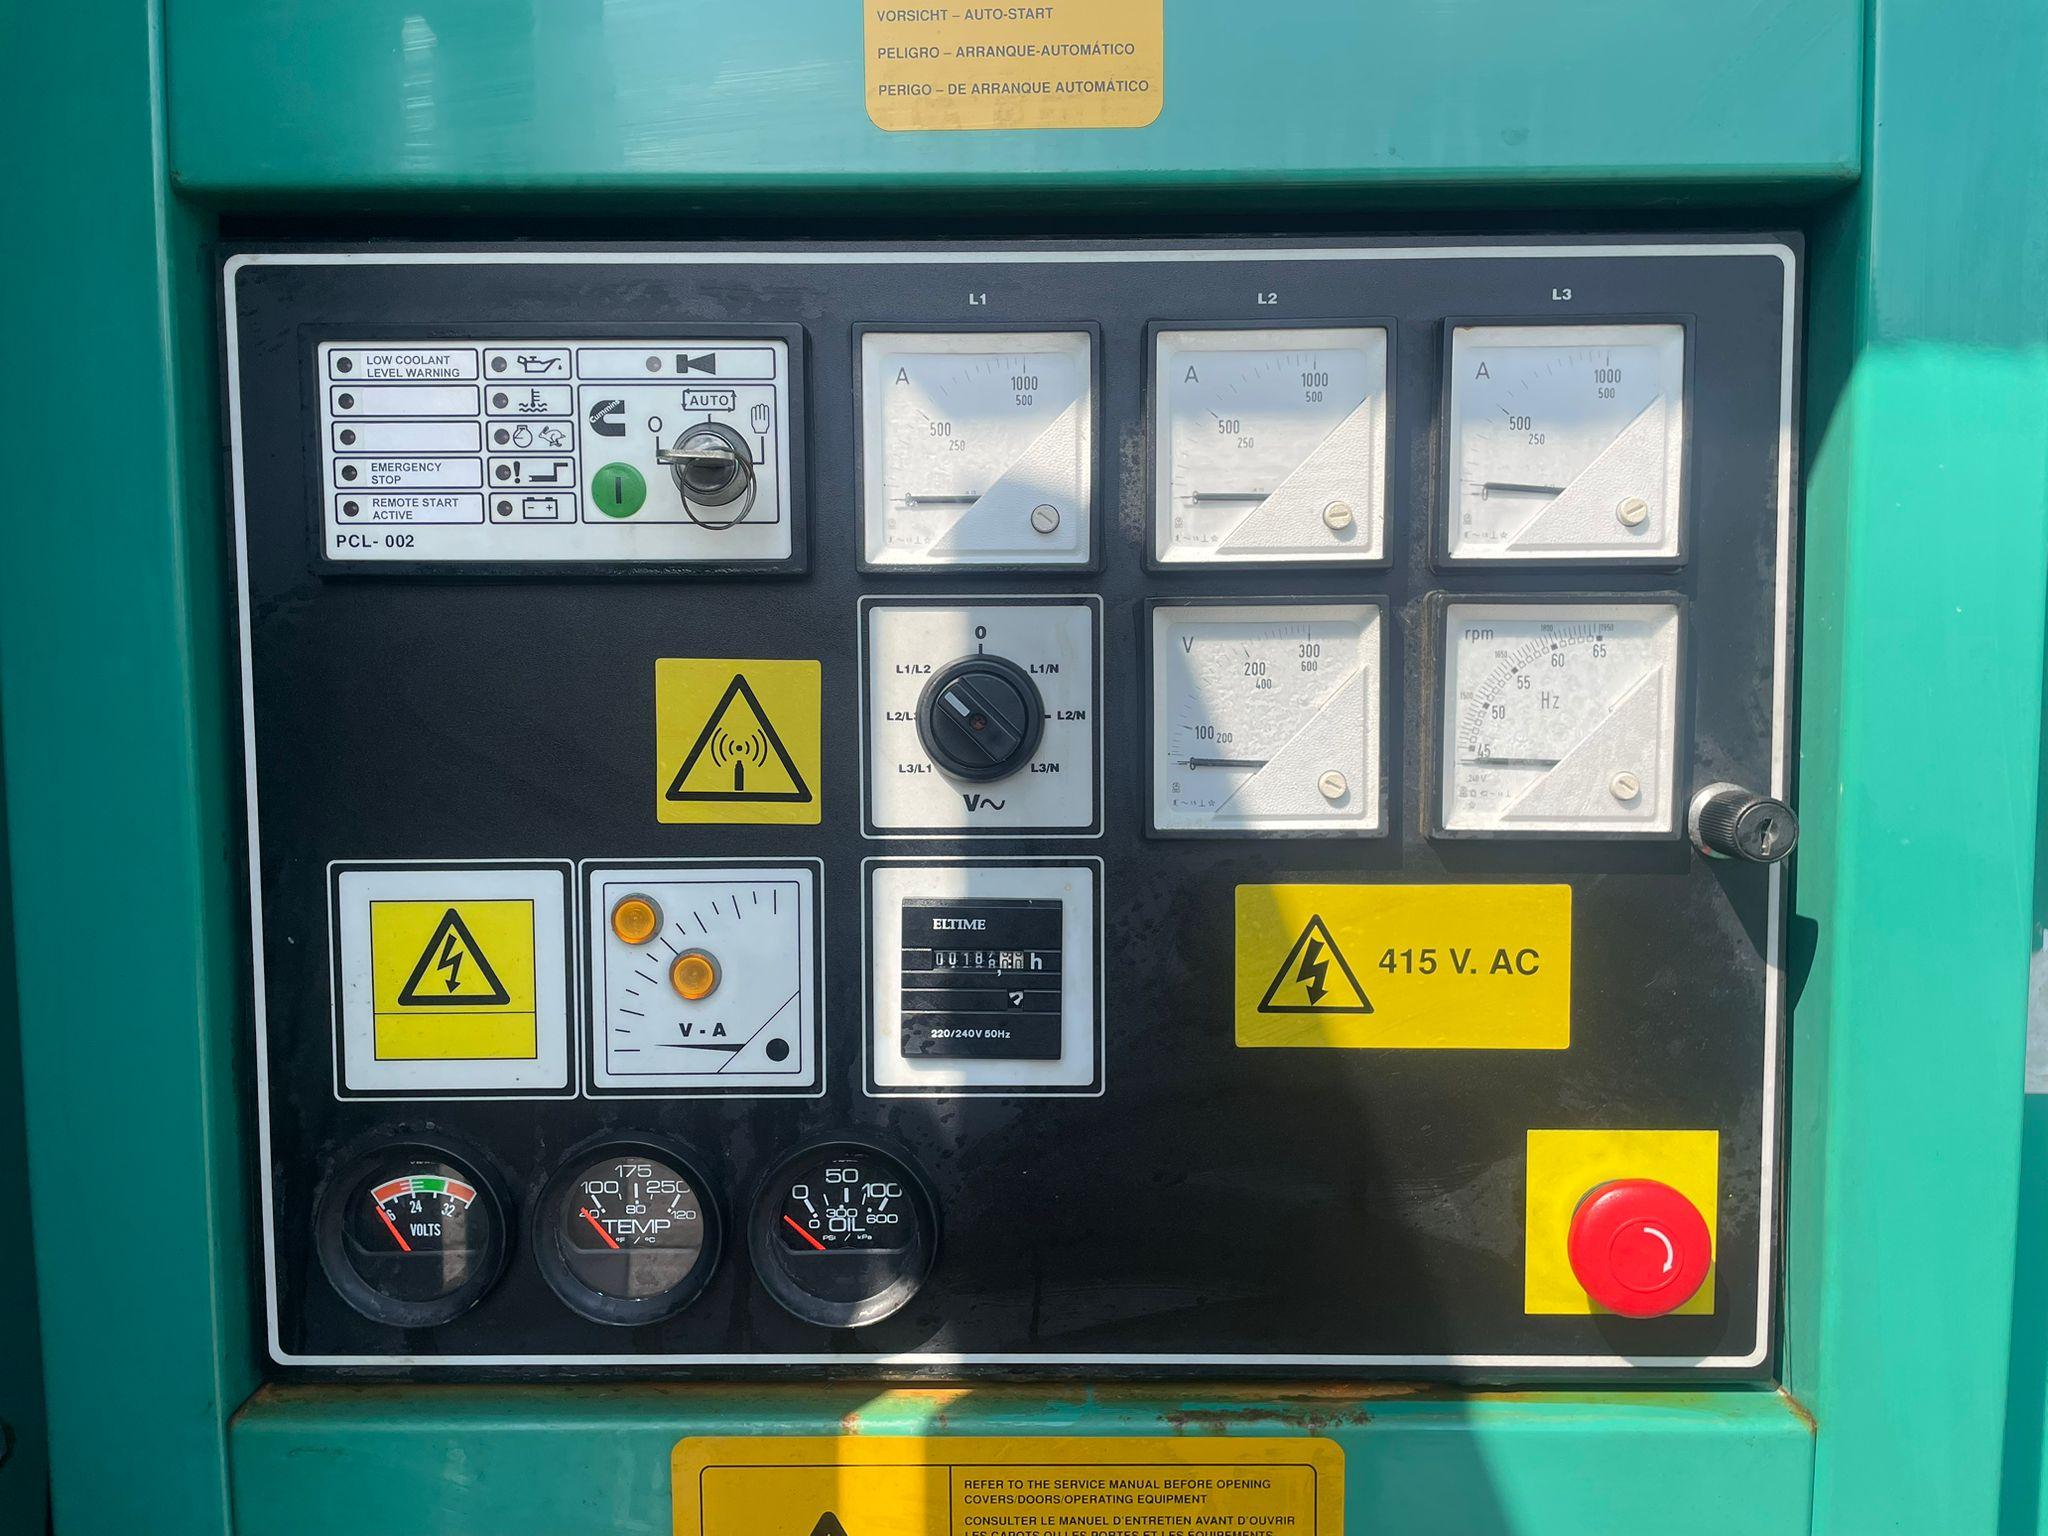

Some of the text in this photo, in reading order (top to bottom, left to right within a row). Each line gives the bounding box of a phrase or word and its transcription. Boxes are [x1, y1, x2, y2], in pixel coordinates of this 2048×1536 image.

[877, 10, 948, 22] VORSICHT
[964, 7, 1054, 20] AUTO-START
[878, 47, 940, 59] PELIGRO
[955, 40, 1135, 58] ARRANQUE-AUTOMÁTICO
[878, 84, 932, 96] PERIGO
[948, 83, 966, 95] DE
[971, 82, 1050, 95] ARRANQUE
[1055, 77, 1149, 93] AUTOMÁTICO
[969, 293, 987, 305] L1
[1257, 293, 1278, 304] L2
[1552, 288, 1572, 300] L3
[366, 356, 450, 365] LOW COOLANT
[367, 368, 460, 378] LEVEL WARNING
[895, 367, 910, 385] A
[1184, 365, 1199, 384] A
[1475, 361, 1490, 380] A
[1594, 369, 1622, 383] 1000
[1011, 376, 1038, 391] 1000
[1301, 373, 1328, 388] 1000
[1306, 391, 1323, 403] 500
[1598, 387, 1615, 399] 500
[689, 395, 729, 406] AUTO
[1016, 395, 1033, 406] 500
[590, 400, 620, 424] Cummins
[930, 422, 951, 437] 500
[1218, 419, 1240, 434] 500
[1509, 416, 1531, 431] 500
[1238, 437, 1254, 449] 250
[1528, 433, 1545, 445] 250
[949, 440, 966, 452] 250
[371, 462, 442, 472] EMERGENCY
[371, 475, 401, 485] STOP
[372, 498, 459, 508] REMOTE START
[372, 511, 413, 520] ACTIVE
[336, 534, 415, 548] PCL- 002
[1465, 627, 1494, 643] rpm
[1182, 636, 1194, 653] V
[1299, 643, 1320, 658] 300
[1593, 644, 1606, 658] 65
[1301, 660, 1318, 672] 600
[1551, 653, 1565, 667] 60
[896, 664, 931, 675] L1/L2
[1031, 663, 1059, 675] L1/N
[1244, 662, 1266, 676] 200
[1255, 678, 1272, 690] 400
[1517, 675, 1530, 689] 55
[1057, 710, 1086, 721] L2/N
[1491, 705, 1505, 719] 50
[1195, 725, 1214, 740] 100
[1216, 732, 1233, 744] 200
[1477, 743, 1491, 758] 45
[899, 764, 932, 775] L3/L1
[1031, 763, 1060, 774] L3/N
[933, 918, 986, 930] ELTIME
[1378, 948, 1540, 976] 415 V. AC
[679, 1022, 692, 1037] V
[712, 1022, 727, 1037] A
[931, 1029, 1011, 1039] 220/240V 50Hz
[614, 1164, 652, 1178] 175
[825, 1168, 859, 1184] 50
[580, 1181, 619, 1194] 100
[646, 1181, 691, 1194] 250
[861, 1183, 902, 1198] 100
[409, 1200, 423, 1214] 24
[440, 1202, 456, 1218] 32
[625, 1205, 646, 1215] 80
[825, 1208, 858, 1218] 300
[671, 1210, 696, 1220] 120
[866, 1214, 898, 1224] 600
[410, 1223, 441, 1236] VOLTS
[602, 1219, 671, 1234] TEMP
[829, 1218, 866, 1232] OIL
[964, 1479, 1271, 1489] REFER TO THE SERVICE MANUAL BEFORE OPENING
[964, 1494, 1208, 1504] COVERS/DOORS/OPERATING EQUIPMENT
[964, 1516, 1296, 1526] CONSULTER LE MANUEL D'ENTRETIEN AVANT D'OUVRIR
